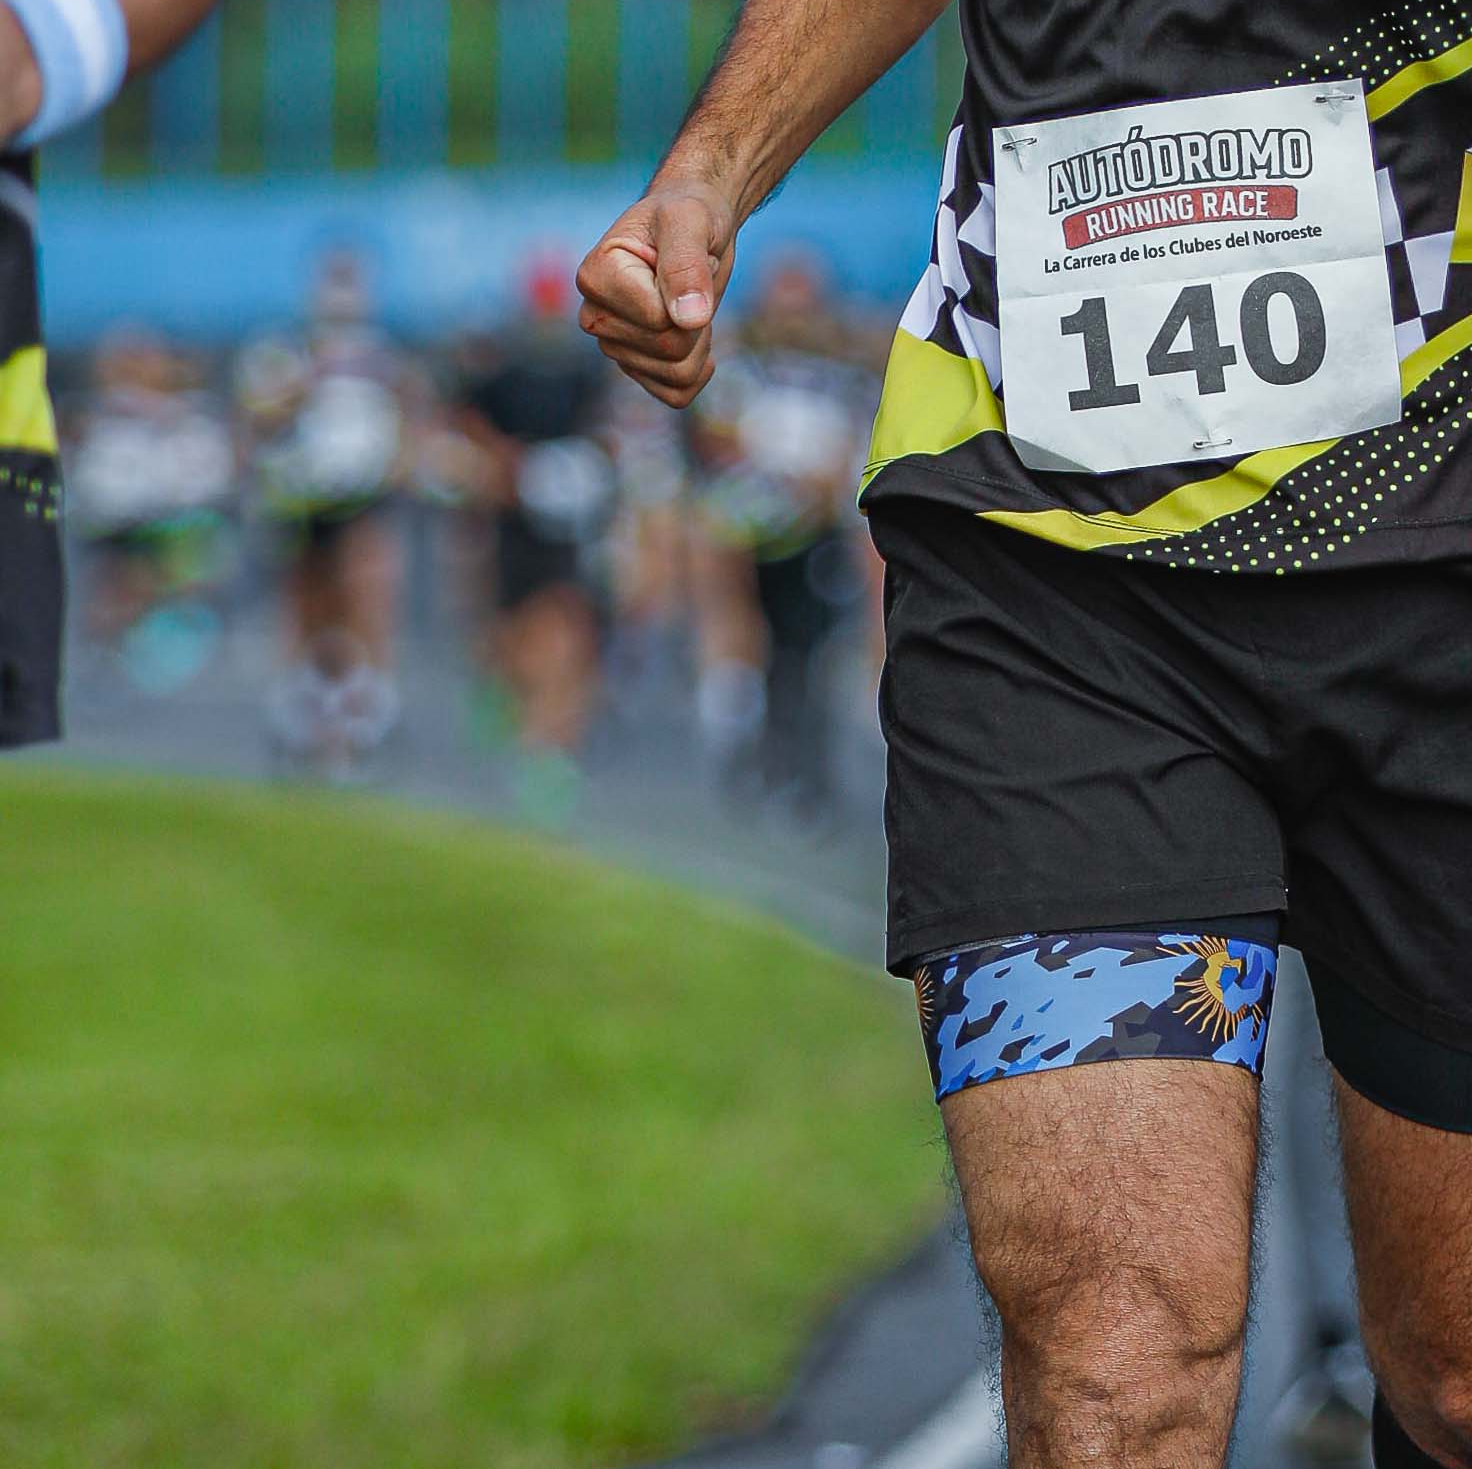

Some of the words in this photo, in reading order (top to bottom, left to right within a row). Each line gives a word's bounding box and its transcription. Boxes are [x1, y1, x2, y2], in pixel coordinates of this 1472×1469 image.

[1048, 125, 1313, 215] AUTÓDROMO
[1044, 258, 1061, 274] La
[1063, 253, 1117, 271] Carrera
[1120, 246, 1140, 263] de
[1143, 243, 1166, 260] los
[1169, 236, 1223, 255] Clubes
[1225, 231, 1250, 247] del
[1253, 224, 1323, 245] Noroeste
[1086, 194, 1195, 240] RUNNING
[1203, 189, 1269, 219] RACE
[1060, 271, 1327, 412] 140
